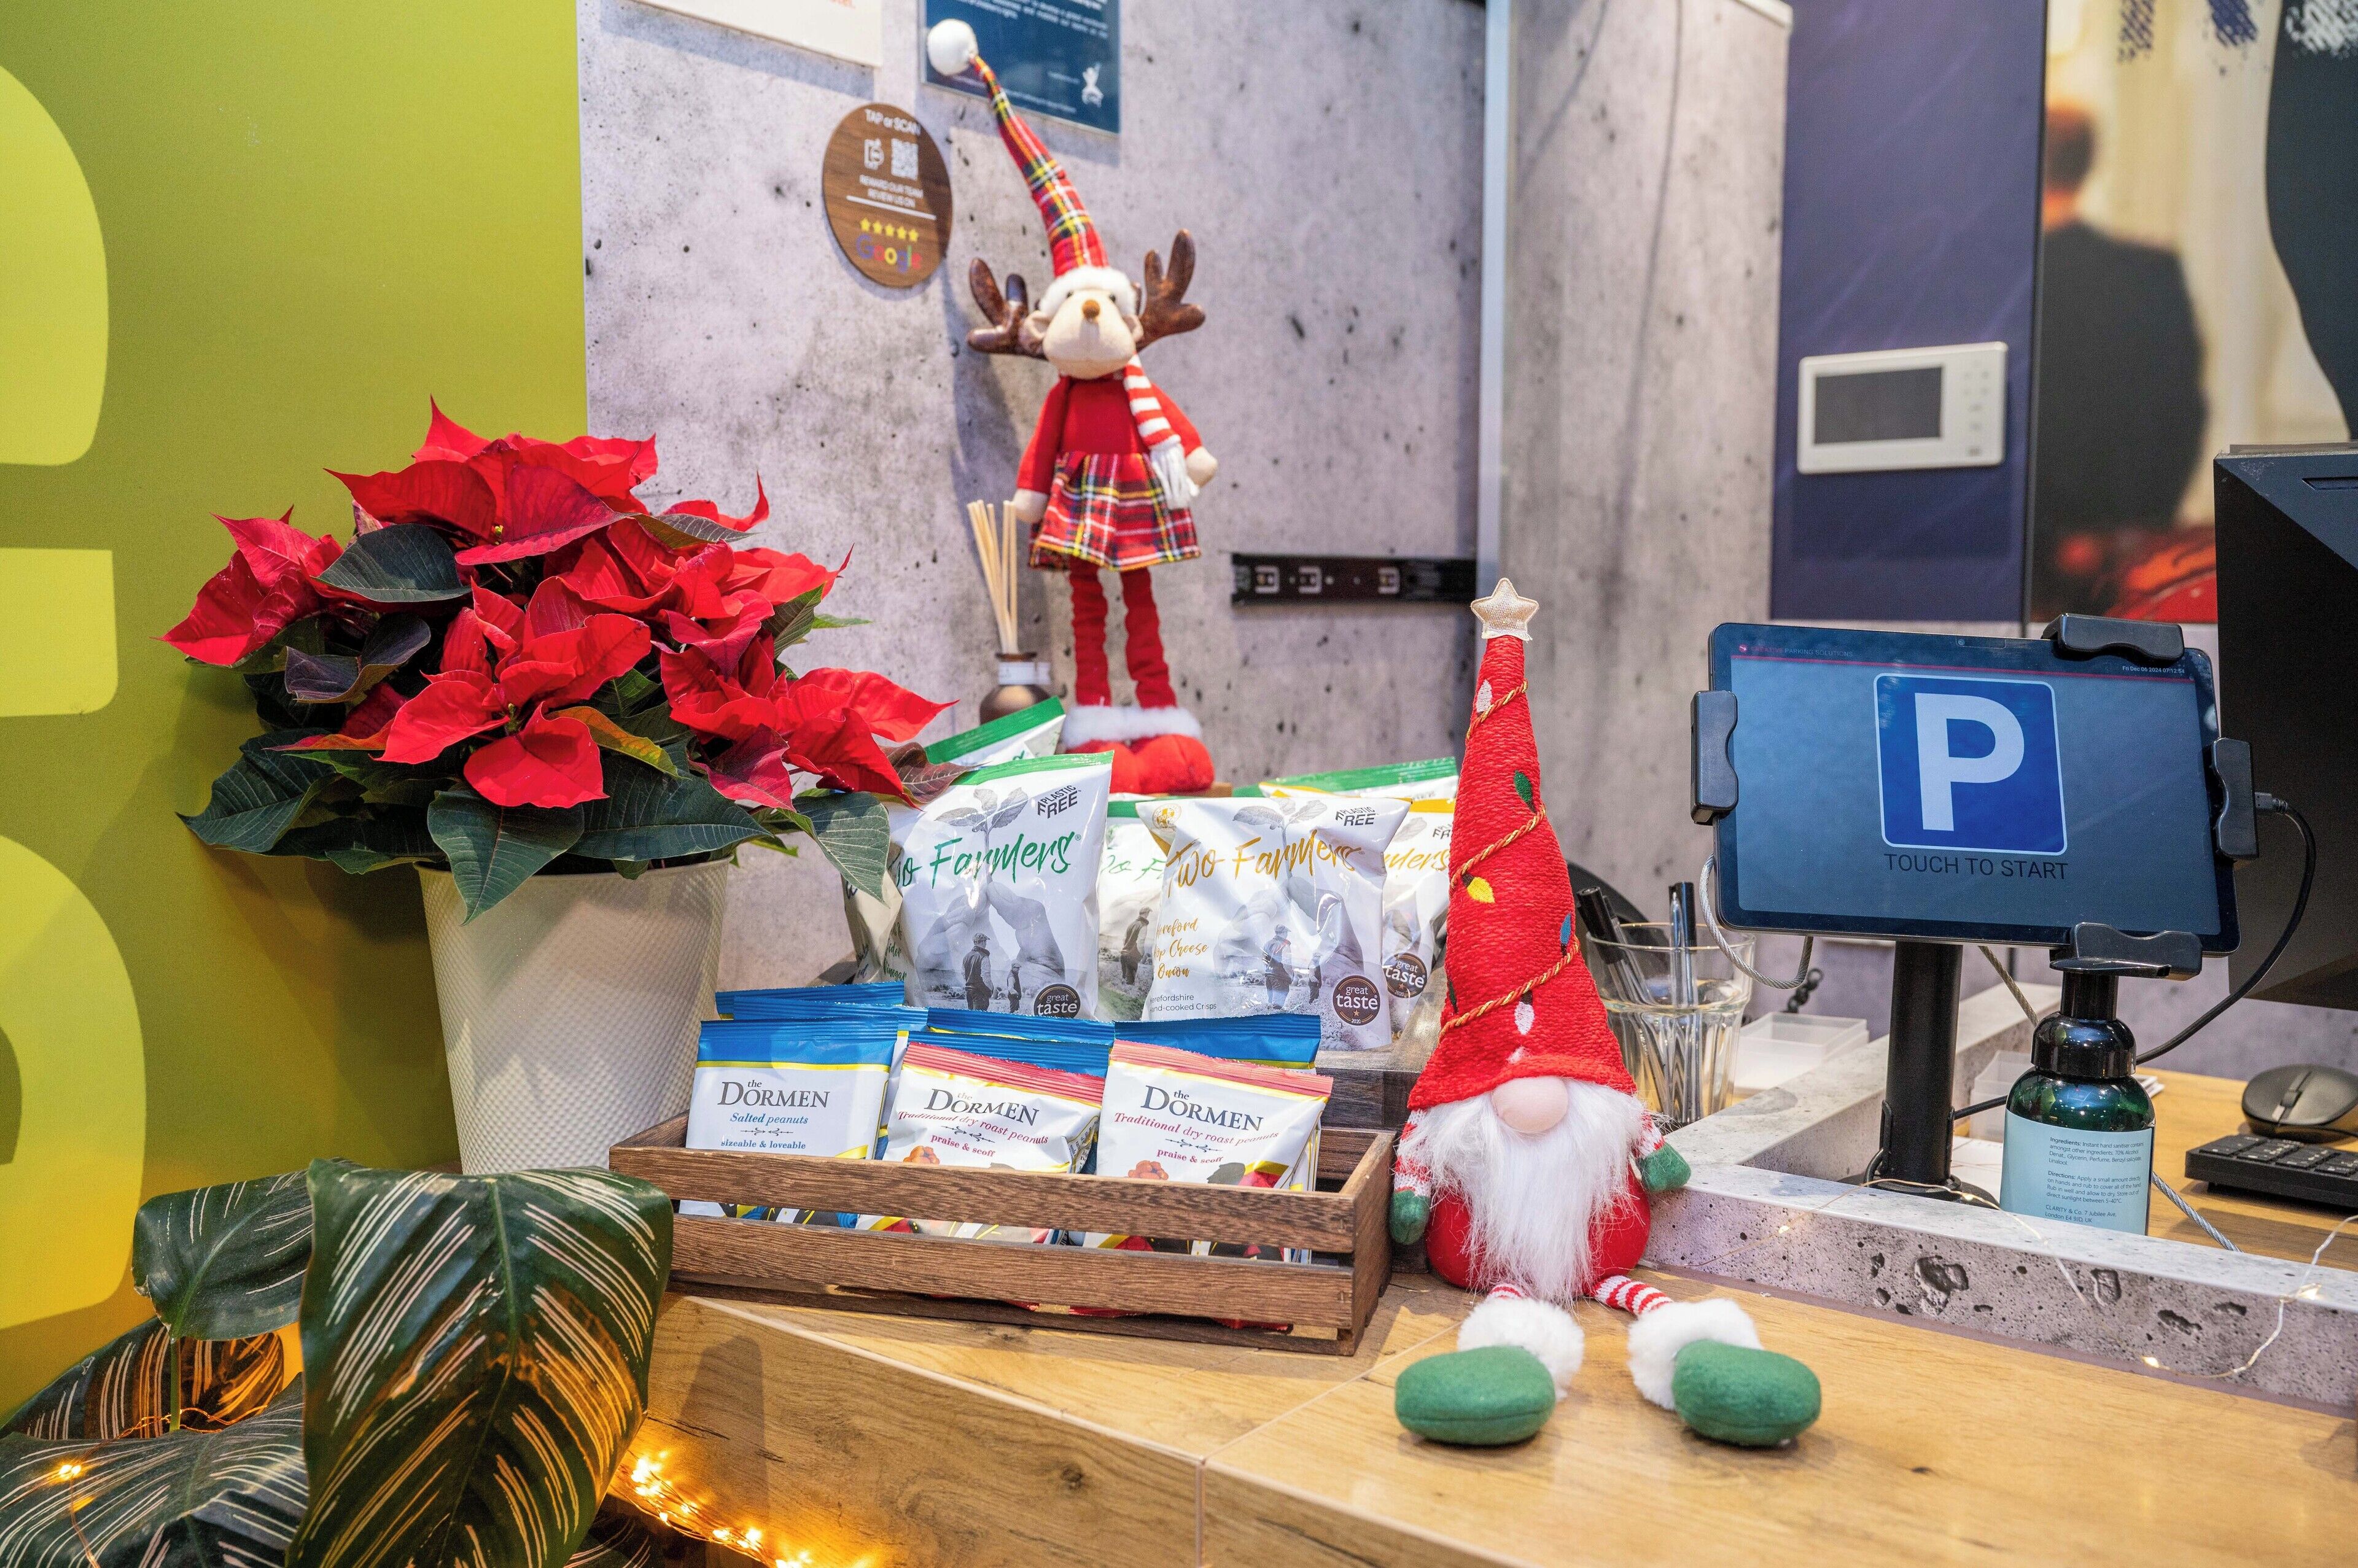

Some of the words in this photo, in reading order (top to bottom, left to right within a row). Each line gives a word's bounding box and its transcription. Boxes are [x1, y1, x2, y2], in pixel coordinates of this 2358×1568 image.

[856, 233, 922, 273] Google
[1915, 693, 2025, 831] P
[1040, 785, 1076, 804] PLASTIC
[1038, 790, 1078, 819] FREE
[1335, 811, 1376, 826] FREE
[1166, 839, 1224, 898] Two
[1884, 853, 1959, 874] TOUCH
[1965, 858, 1993, 876] TO
[2001, 860, 2068, 880] START
[1169, 937, 1208, 958] Cheese
[1158, 963, 1190, 979] Onion
[1396, 960, 1418, 973] great
[1385, 965, 1425, 988] taste
[1046, 993, 1069, 1003] great
[1345, 986, 1369, 996] great
[1037, 1002, 1078, 1015] taste
[1196, 1003, 1217, 1012] Crisps
[1336, 993, 1378, 1010] taste
[747, 1079, 762, 1088] the
[717, 1081, 831, 1108] DORMEN
[957, 1092, 973, 1101] the
[1173, 1090, 1189, 1100] the
[924, 1088, 1040, 1127] DORMEN
[1140, 1085, 1264, 1131] DORMEN
[730, 1112, 766, 1124] Salted
[765, 1116, 809, 1127] peanuts
[898, 1111, 959, 1122] Traditional
[962, 1114, 979, 1127] dry
[980, 1120, 1008, 1136] roast
[1007, 1130, 1049, 1144] peanuts
[1114, 1112, 1181, 1133] Traditional
[1183, 1126, 1203, 1140] dry
[1205, 1134, 1234, 1144] roast
[1235, 1131, 1279, 1146] peanuts
[721, 1138, 757, 1148] sizeable
[769, 1140, 806, 1150] loveable
[931, 1135, 960, 1149] praise
[972, 1147, 996, 1158] scoff
[2050, 1137, 2081, 1146] Ingredients:
[1156, 1149, 1187, 1162] praise
[1189, 1155, 1198, 1163] &
[2048, 1170, 2076, 1179] Directions:
[2045, 1205, 2067, 1213] CLARITY
